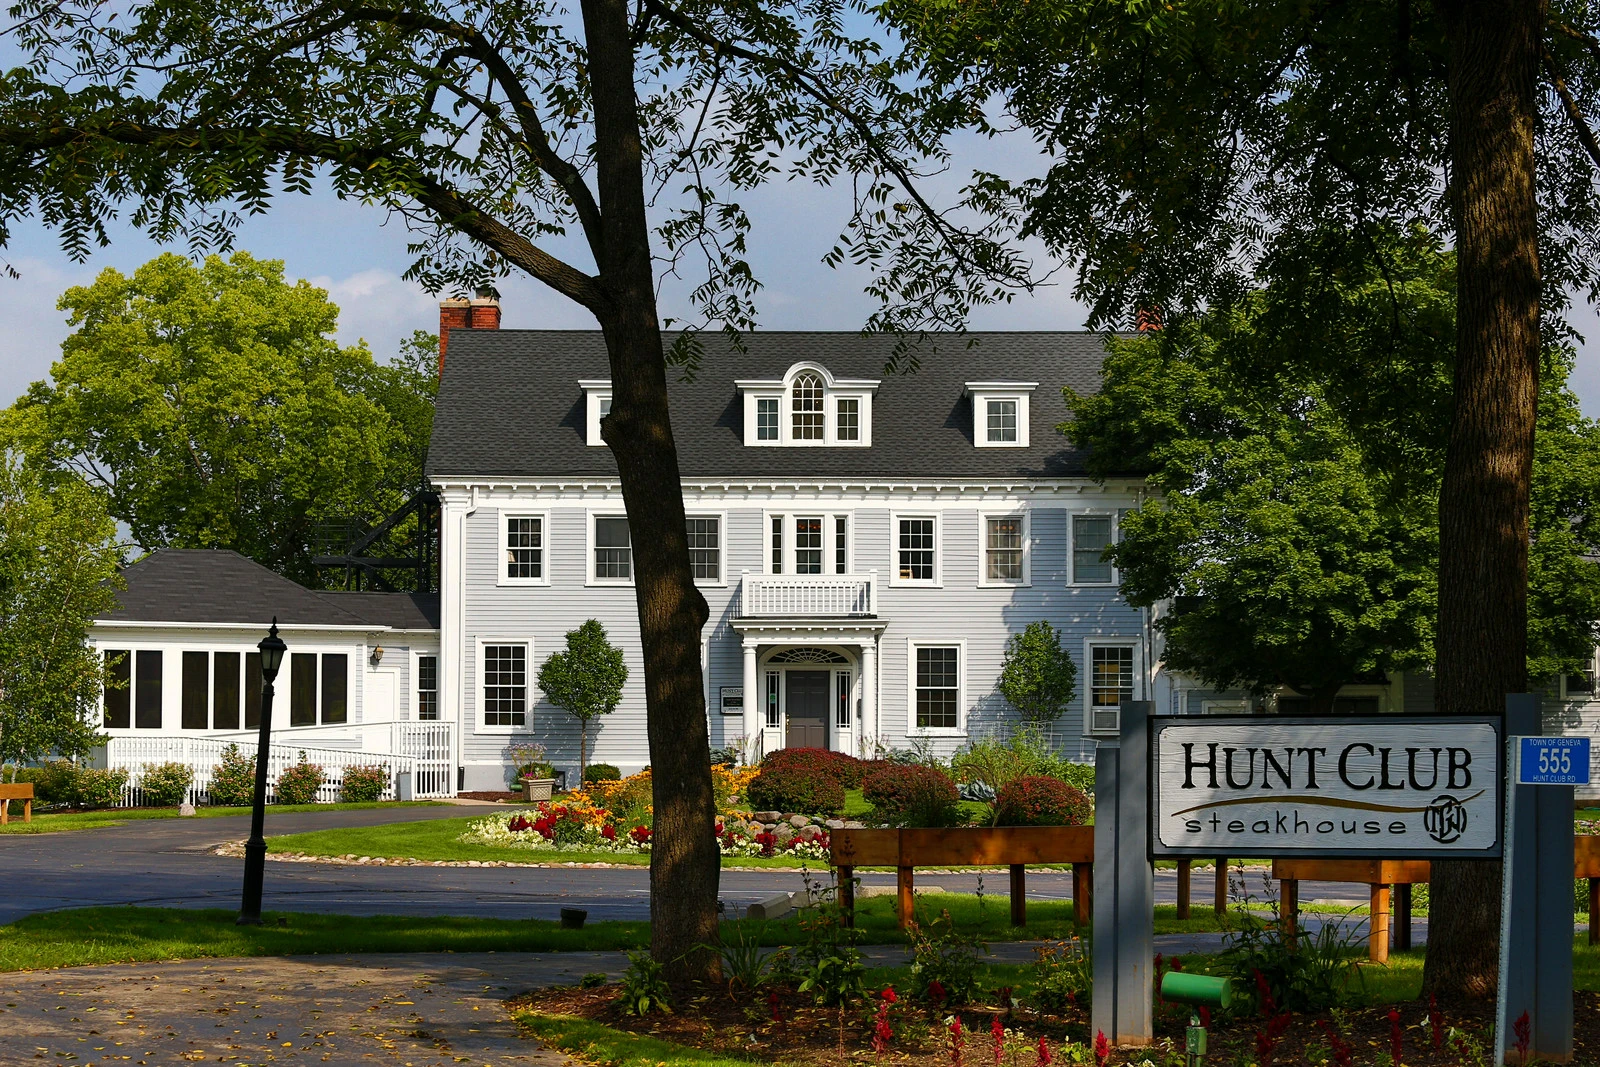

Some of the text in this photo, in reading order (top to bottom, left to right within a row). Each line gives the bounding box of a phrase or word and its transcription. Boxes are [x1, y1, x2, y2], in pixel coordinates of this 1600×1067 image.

[1181, 743, 1472, 790] HUNT CLUB
[1538, 748, 1571, 773] 555
[1185, 808, 1407, 834] steakhouse
